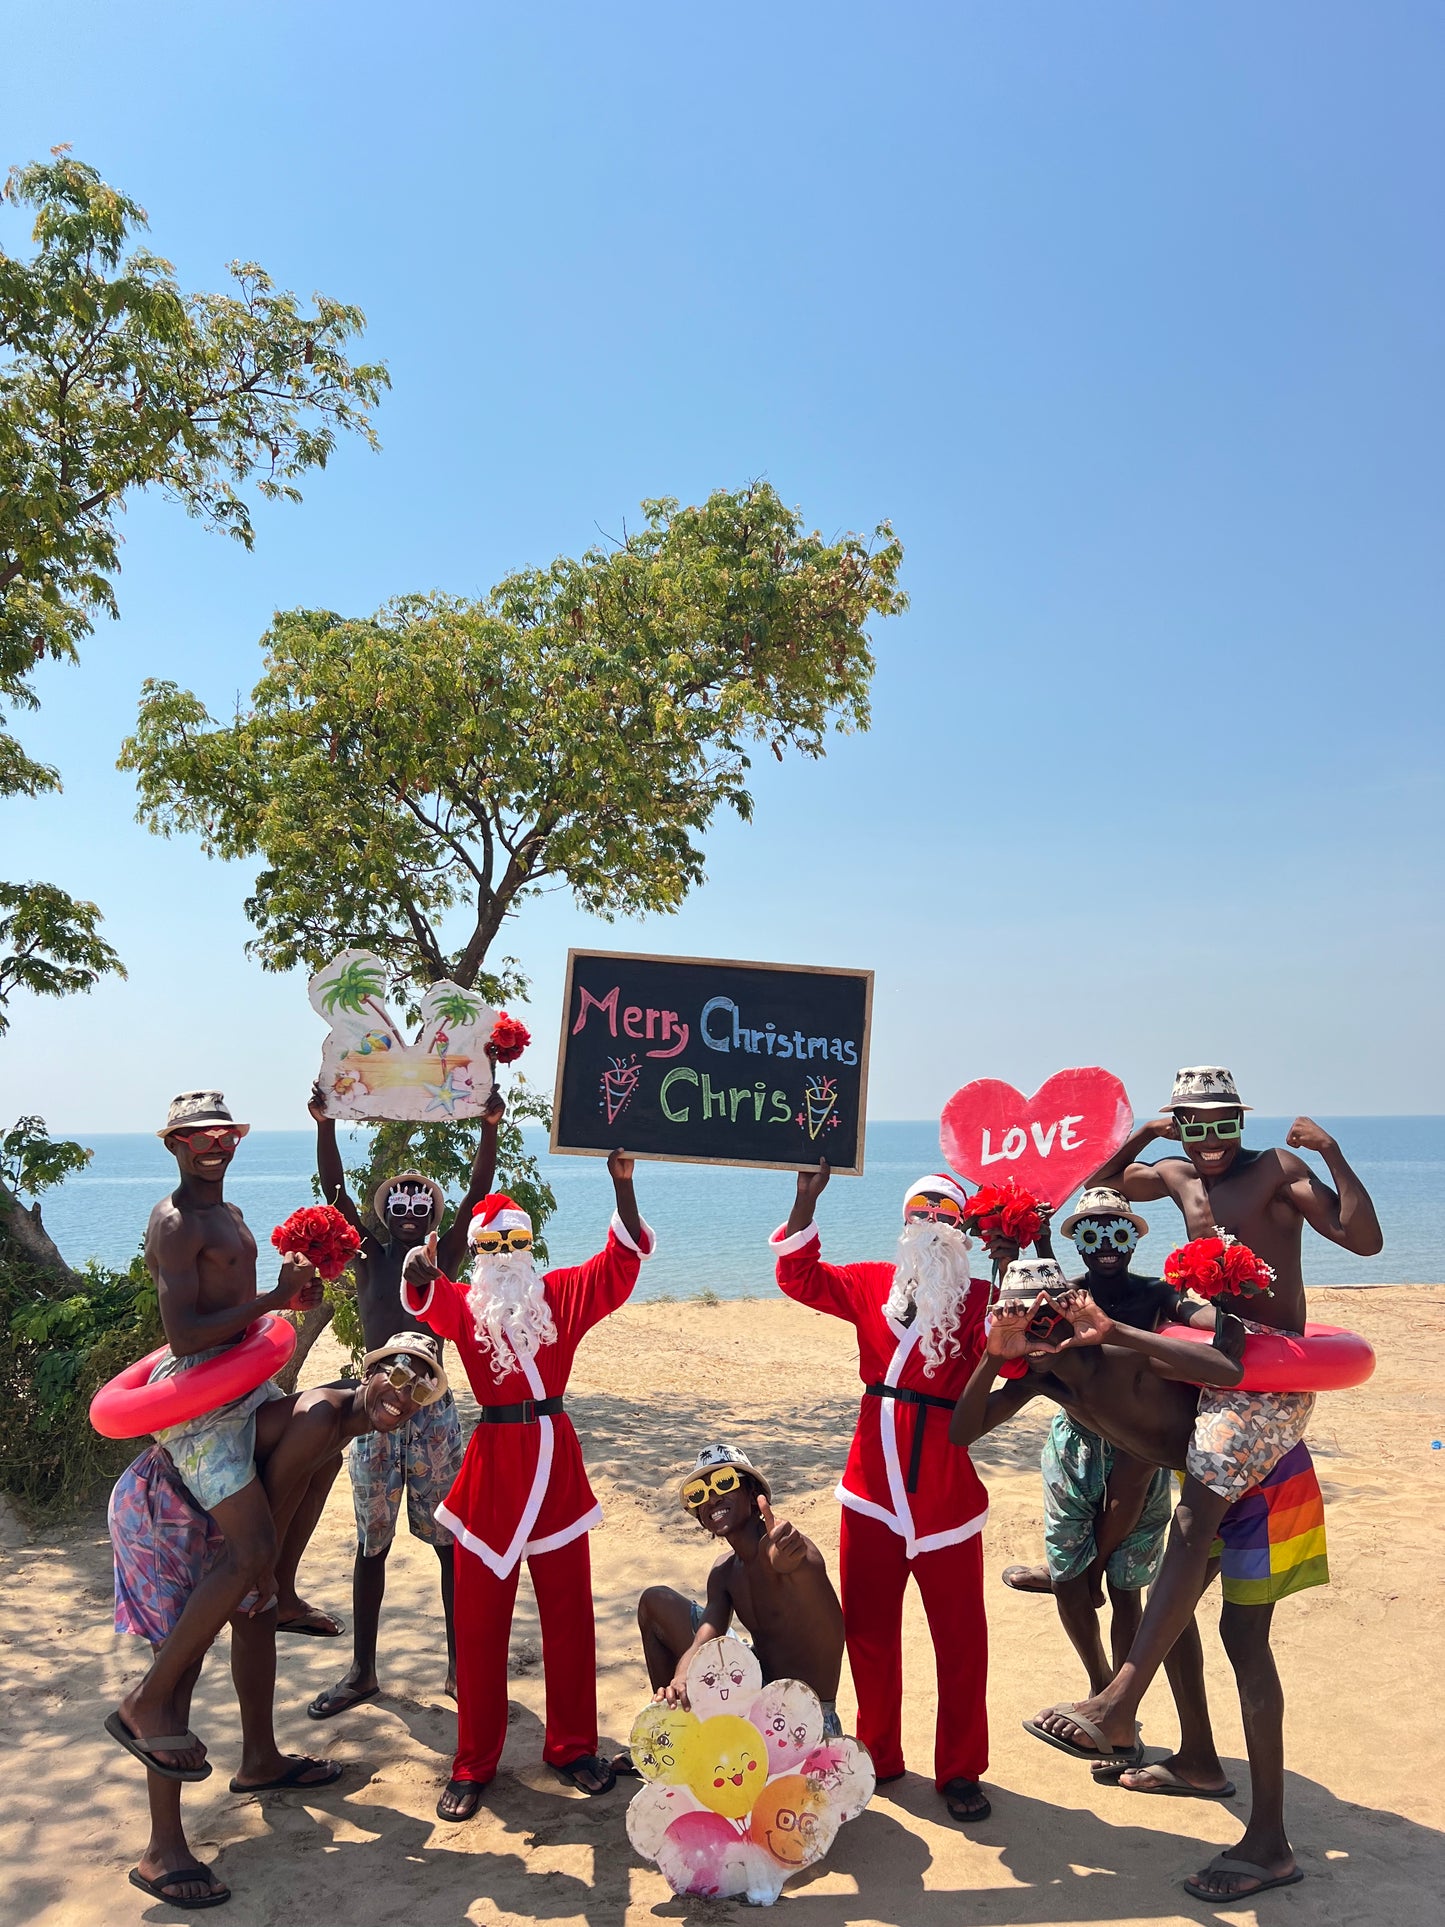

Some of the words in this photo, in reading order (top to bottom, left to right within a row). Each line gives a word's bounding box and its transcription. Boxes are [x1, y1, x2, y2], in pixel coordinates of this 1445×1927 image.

[572, 985, 690, 1059] Merry
[700, 995, 858, 1066] Christmas
[660, 1066, 792, 1123] Chris
[981, 1114, 1088, 1166] LOVE
